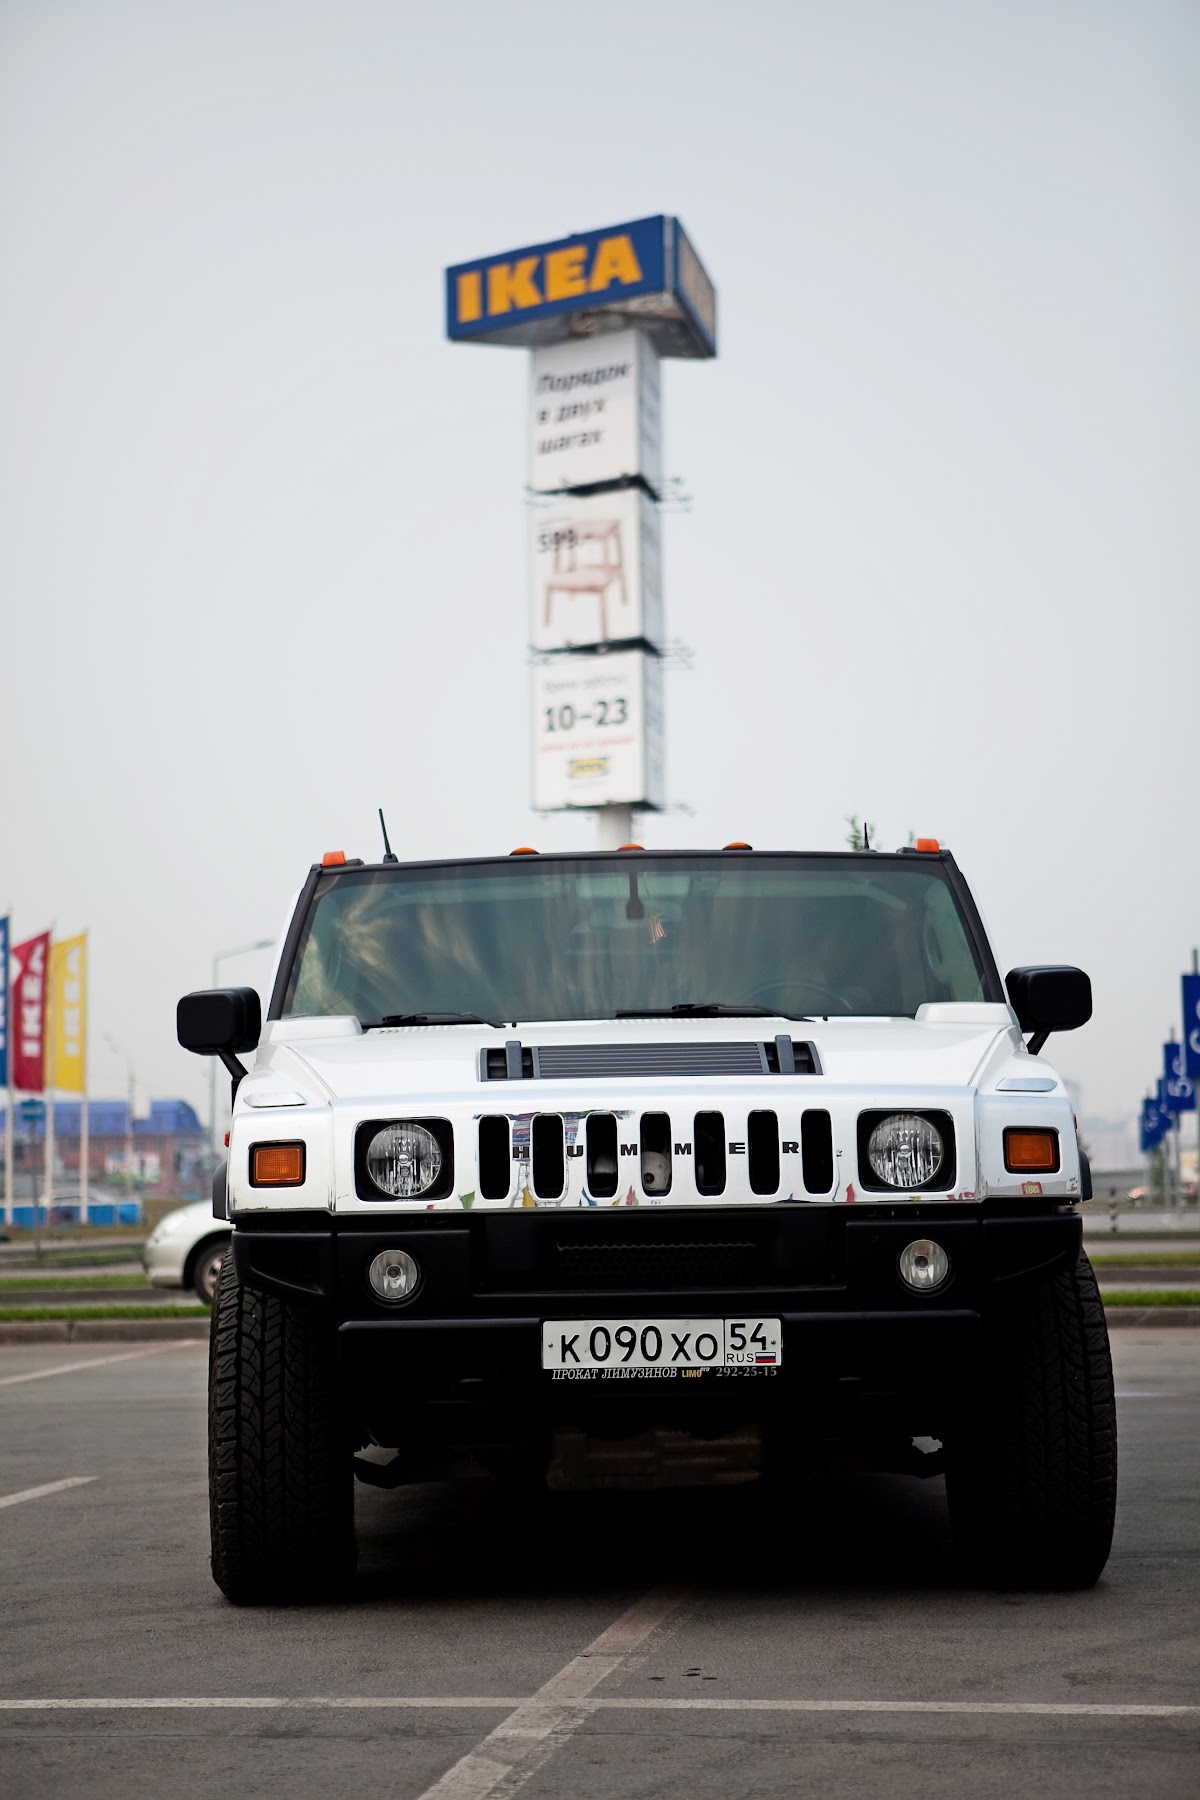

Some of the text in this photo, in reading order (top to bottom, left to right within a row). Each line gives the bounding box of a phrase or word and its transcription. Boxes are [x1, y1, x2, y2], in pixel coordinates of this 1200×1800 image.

[457, 234, 643, 322] IKEA
[21, 942, 45, 1059] IKEA
[512, 1141, 800, 1159] HUMMER
[729, 1323, 767, 1351] 54
[726, 1353, 754, 1363] RUS
[552, 1368, 599, 1380] ПРОКАТ
[601, 1367, 678, 1379] ЛИМУЗИНОВ
[716, 1366, 778, 1377] 292-25-15
